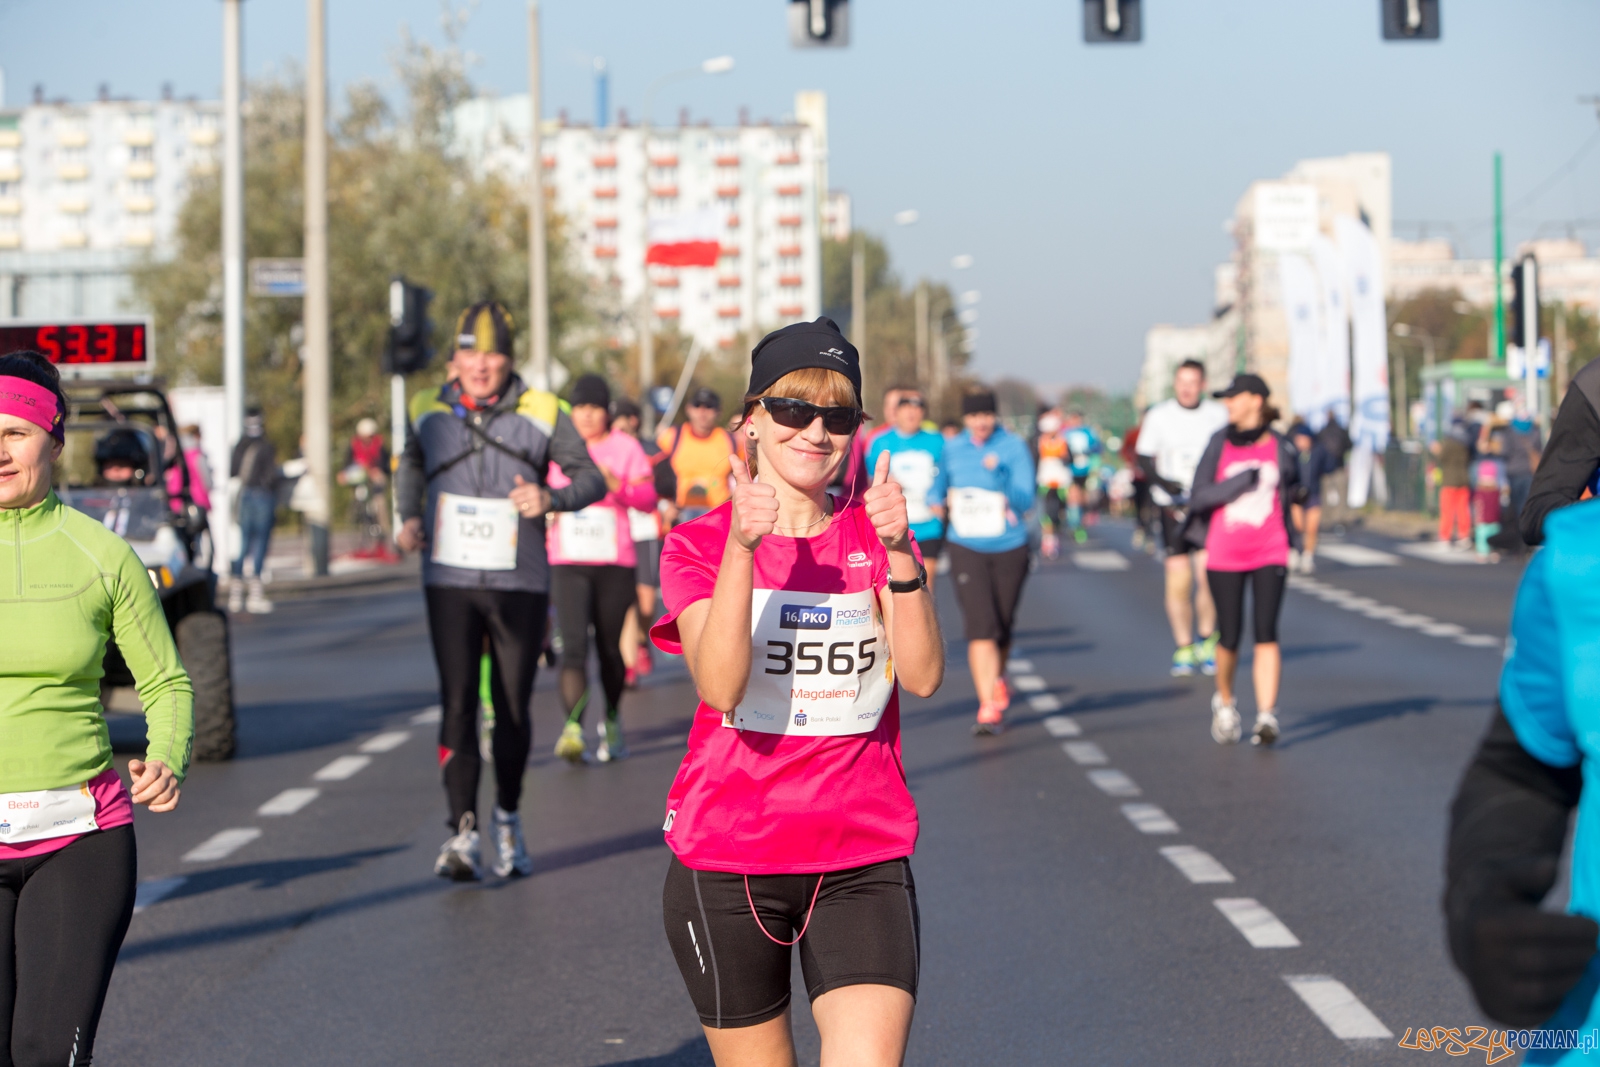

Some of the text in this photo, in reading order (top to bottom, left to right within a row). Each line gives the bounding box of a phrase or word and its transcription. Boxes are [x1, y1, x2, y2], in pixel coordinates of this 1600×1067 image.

[836, 615, 871, 626] maraton
[765, 636, 877, 675] 3565
[790, 688, 856, 701] Magdalena
[8, 800, 40, 809] Beata
